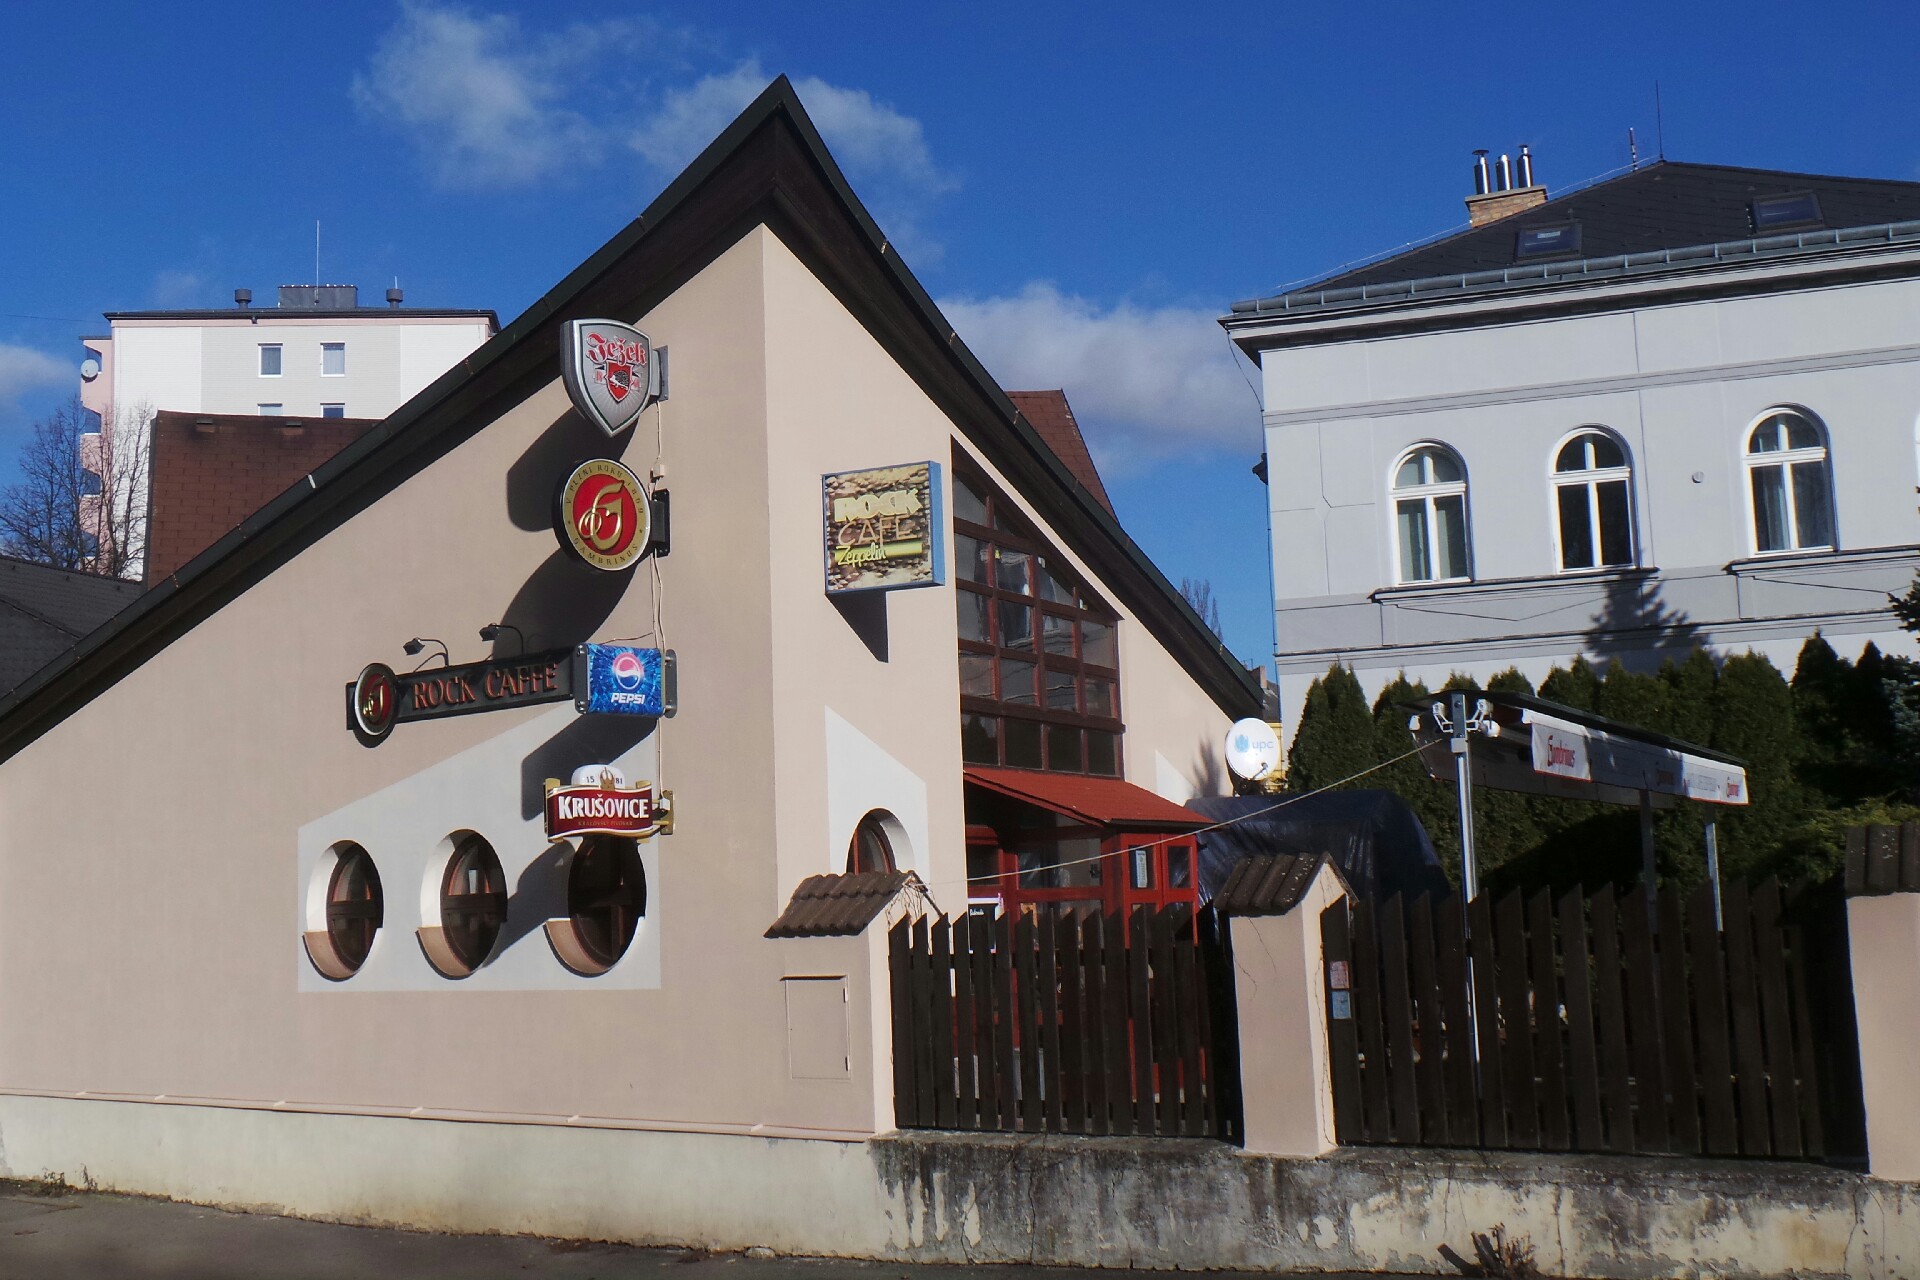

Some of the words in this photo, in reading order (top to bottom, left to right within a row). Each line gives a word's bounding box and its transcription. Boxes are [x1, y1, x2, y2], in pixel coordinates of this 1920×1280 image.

[834, 488, 923, 522] ROCK
[836, 542, 887, 567] Zeppelin
[413, 676, 476, 709] ROCK
[486, 663, 559, 698] CAFFE
[611, 692, 646, 705] PEPSI
[1252, 741, 1274, 752] upc
[615, 777, 623, 785] 81
[558, 793, 650, 820] KRUŠOVICE
